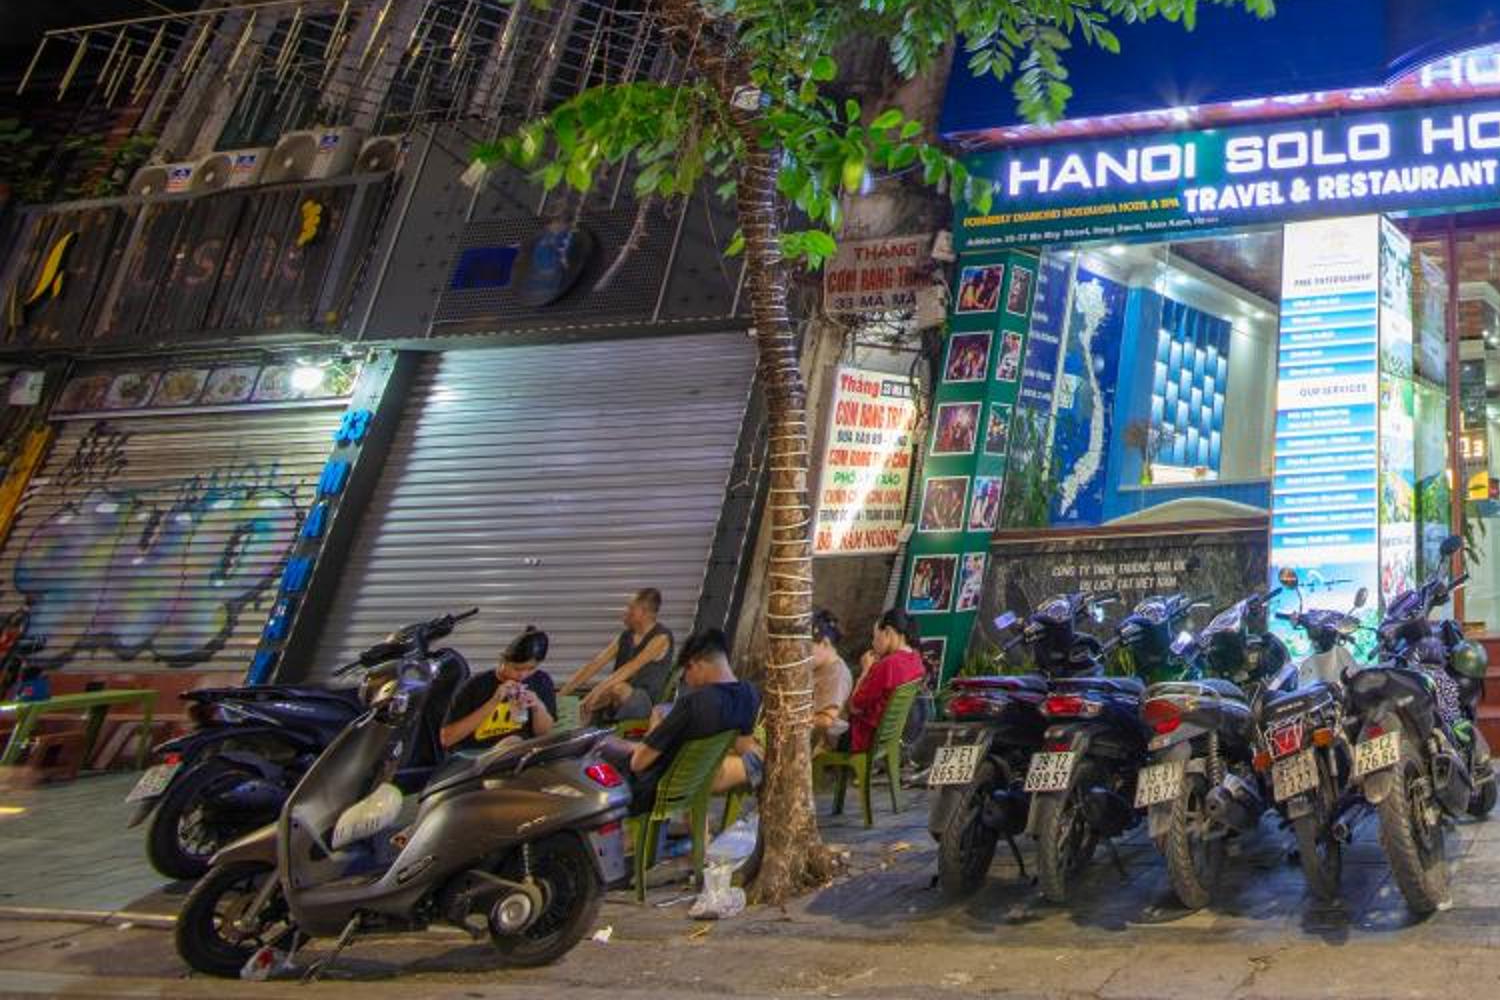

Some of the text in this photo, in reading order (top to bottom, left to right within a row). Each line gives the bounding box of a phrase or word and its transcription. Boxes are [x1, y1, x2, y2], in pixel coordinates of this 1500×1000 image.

[1008, 141, 1196, 196] HANOI
[1226, 123, 1391, 174] SOLO
[1184, 159, 1499, 213] TRAVEL & RESTAURANT
